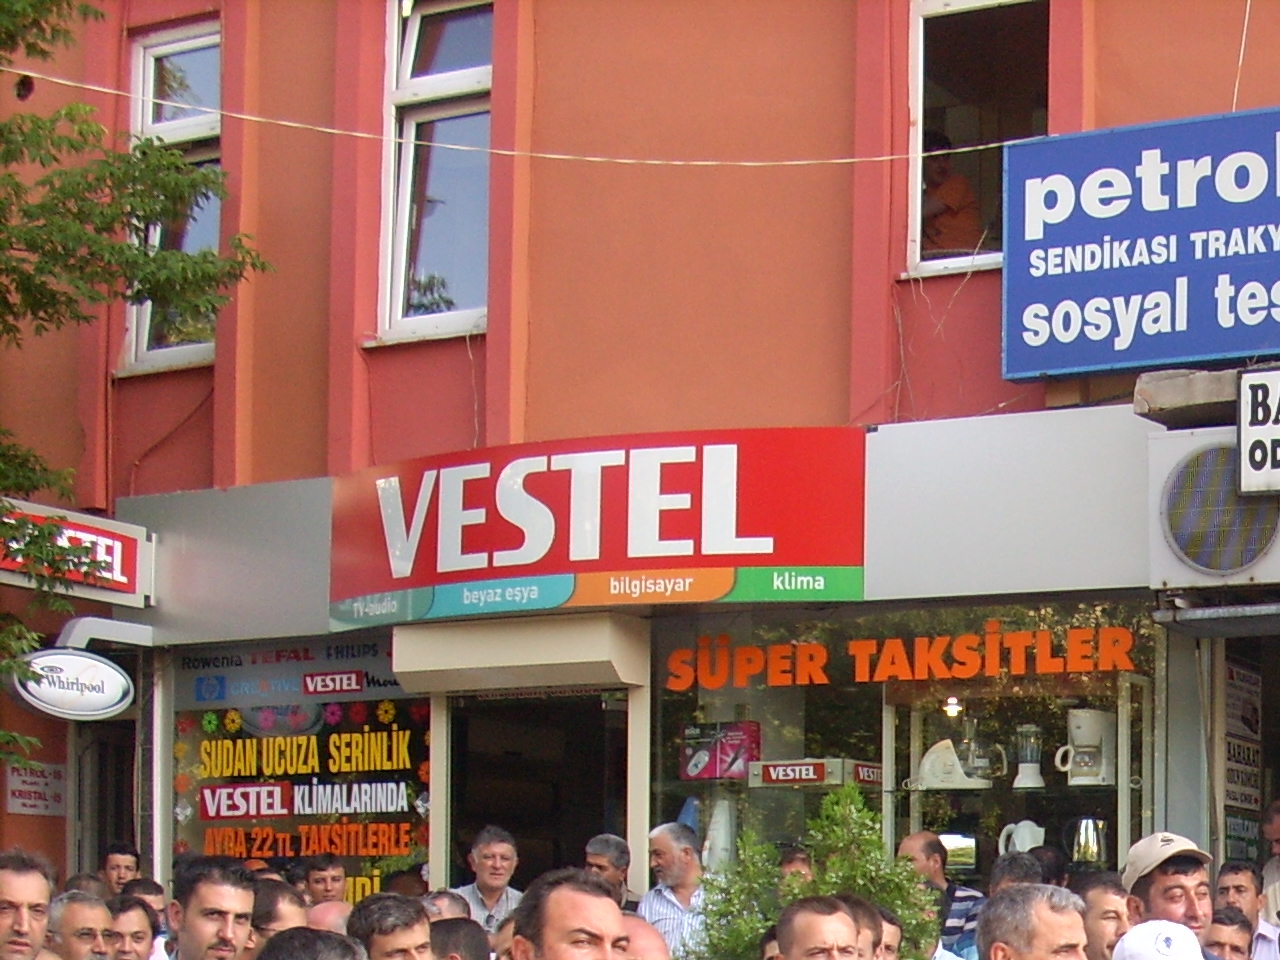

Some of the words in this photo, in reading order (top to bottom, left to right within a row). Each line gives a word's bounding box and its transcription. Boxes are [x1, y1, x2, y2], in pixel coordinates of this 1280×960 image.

[1029, 234, 1177, 277] SENDİKASI
[1022, 276, 1188, 351] sosyal
[375, 443, 774, 579] VESTEL
[463, 587, 504, 605] beyaz
[507, 583, 539, 604] eşya
[609, 575, 693, 596] bilgisayar
[773, 572, 825, 591] klima
[250, 648, 315, 665] TEFAL
[326, 643, 378, 660] PHILIPS
[666, 634, 830, 692] SÜPER
[847, 620, 1135, 683] TAKSİTLER
[44, 674, 105, 696] Whirlpool
[305, 674, 361, 691] VESTEL
[200, 738, 257, 778] SUDAN
[262, 735, 320, 776] UCUZA
[329, 723, 411, 773] SERİNLİK
[769, 765, 818, 780] VESTEL
[204, 785, 289, 817] VESTEL
[293, 777, 409, 815] KLİMALARINDA
[251, 826, 273, 858] 22
[276, 831, 294, 857] TL
[298, 816, 411, 856] TAKSİTLERLE
